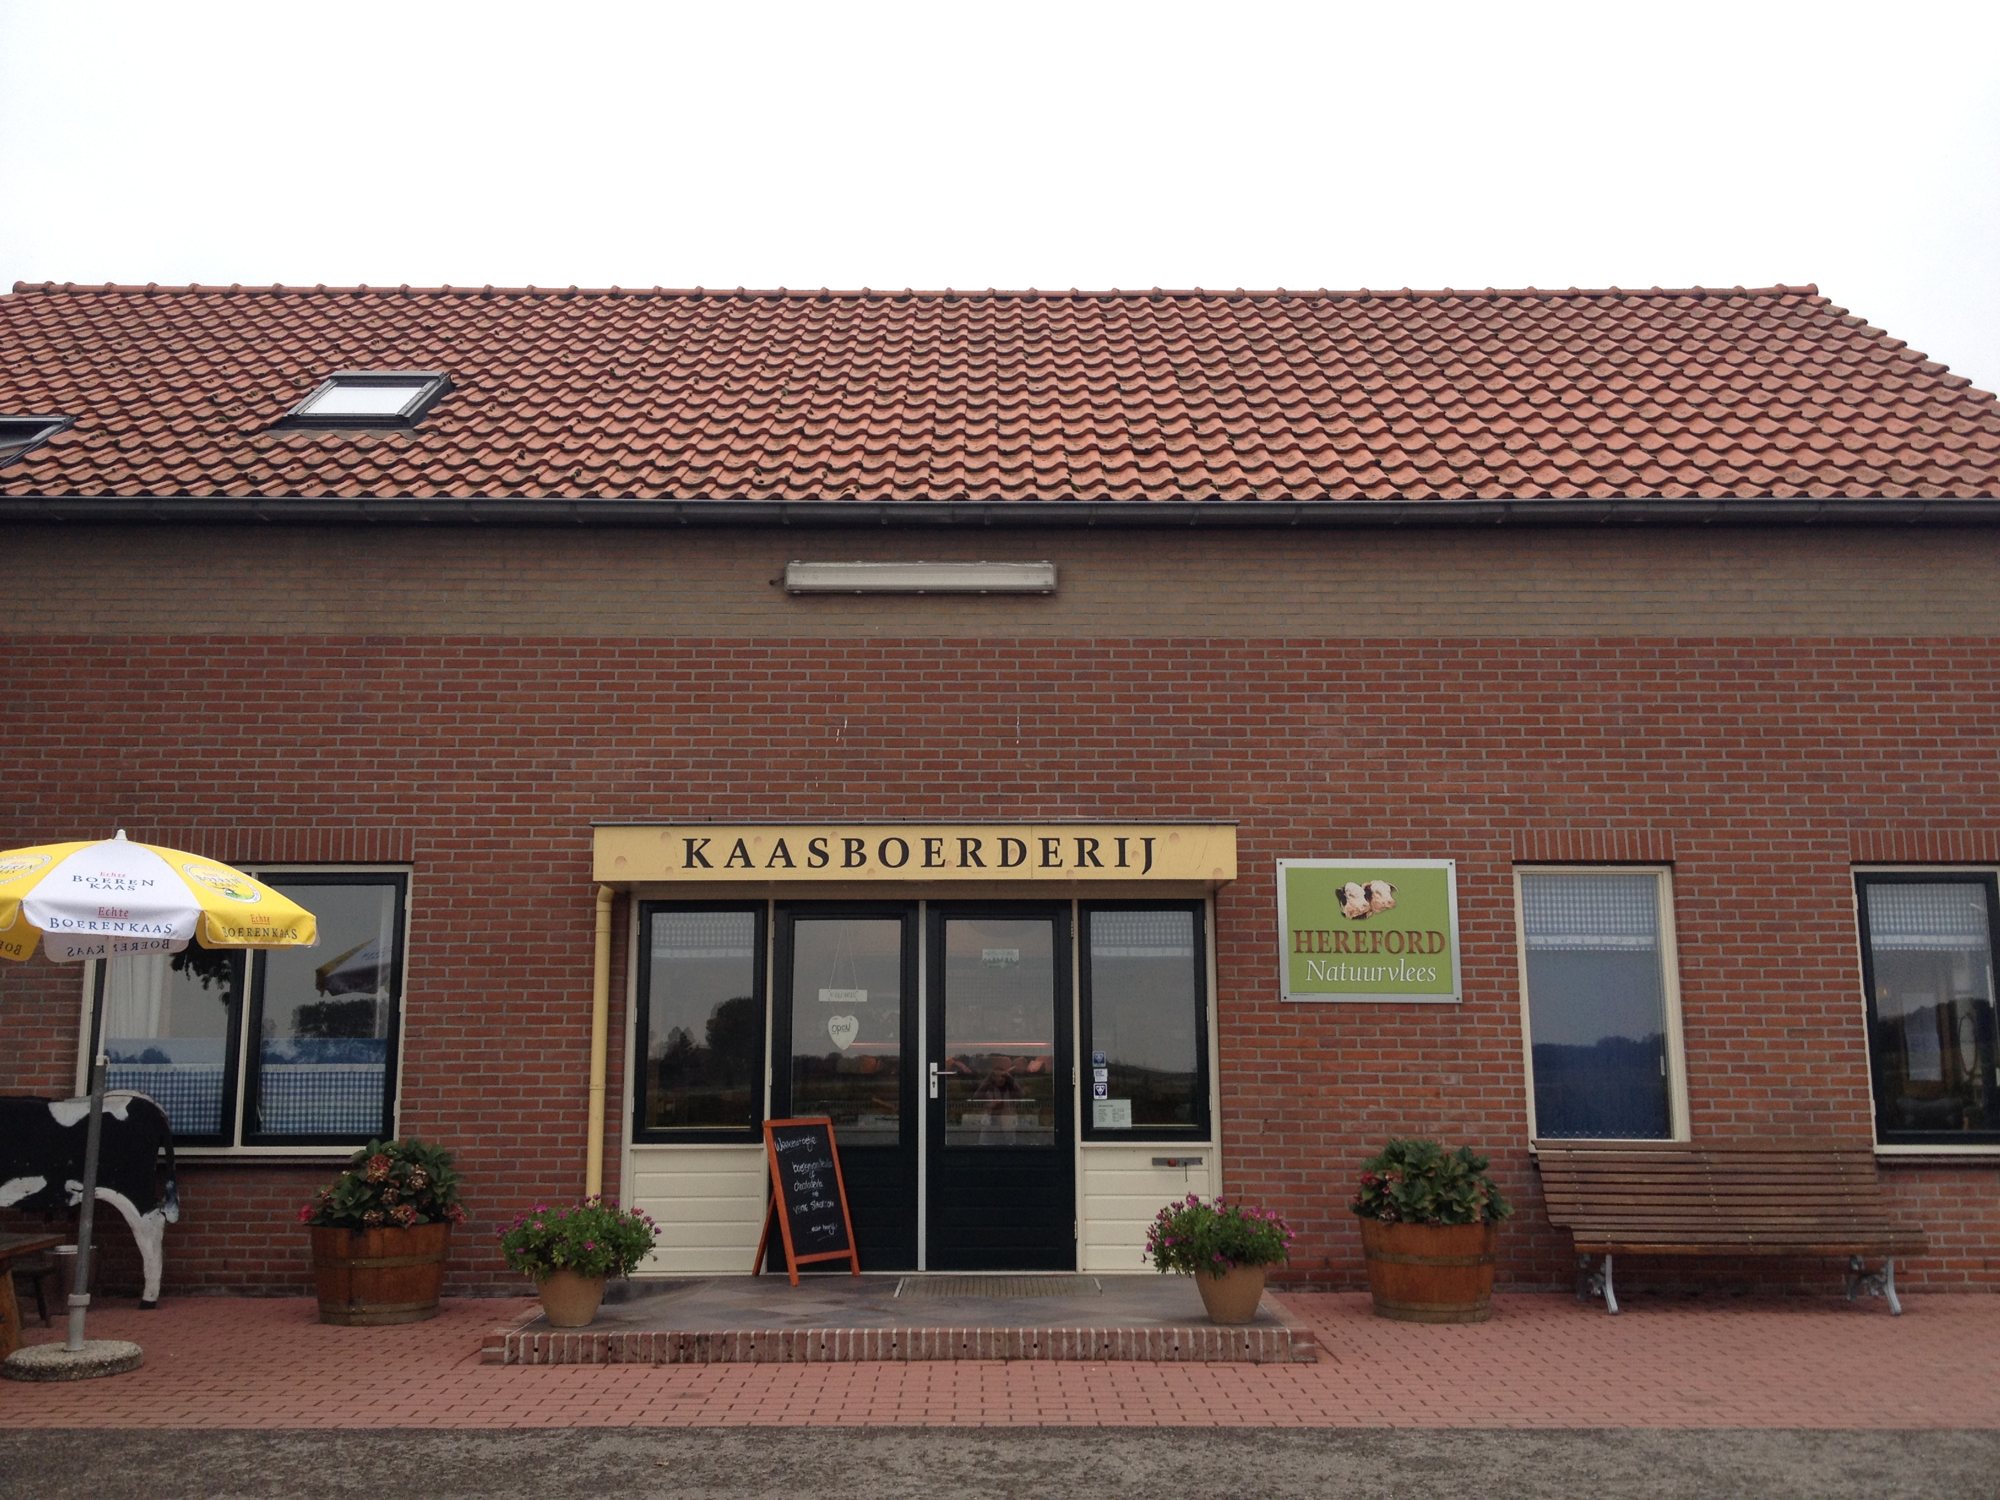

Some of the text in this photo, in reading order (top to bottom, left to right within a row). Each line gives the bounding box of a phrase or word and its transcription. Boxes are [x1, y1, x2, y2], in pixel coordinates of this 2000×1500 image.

[682, 837, 1157, 876] KAASBOERDERIJ
[72, 874, 155, 887] BOEREN
[90, 883, 136, 891] KAAS
[98, 906, 129, 919] Echte
[49, 917, 173, 934] BOERENKAAS
[1293, 930, 1446, 955] HEREFORD
[1305, 958, 1436, 982] Natuurvlees
